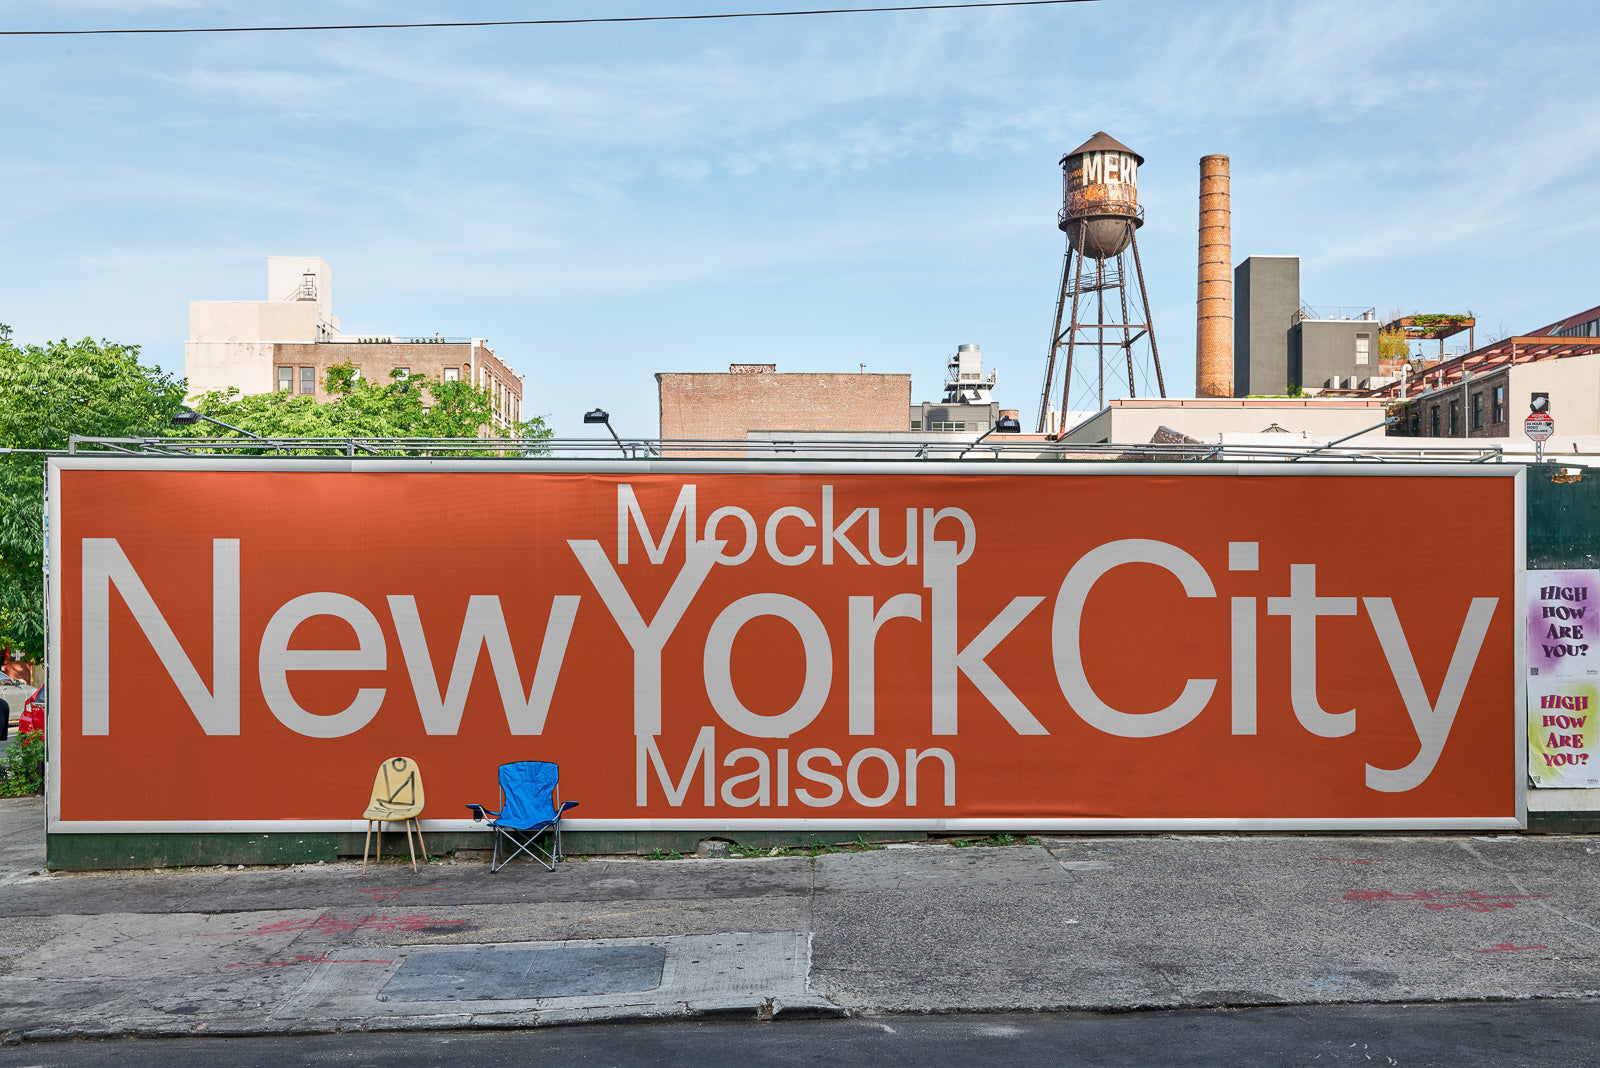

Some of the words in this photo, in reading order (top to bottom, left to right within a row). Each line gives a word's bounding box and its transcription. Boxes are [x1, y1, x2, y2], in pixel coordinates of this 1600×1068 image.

[617, 484, 976, 588] Mockup
[1540, 586, 1588, 602] HIGH
[1542, 606, 1587, 620] HOW
[1546, 623, 1583, 640] ARE
[1541, 644, 1589, 659] YOU?
[1540, 695, 1589, 711] HIGH
[1542, 715, 1587, 729] HOW
[1546, 732, 1584, 749] ARE
[636, 726, 956, 807] Maison
[1541, 753, 1590, 767] YOU?
